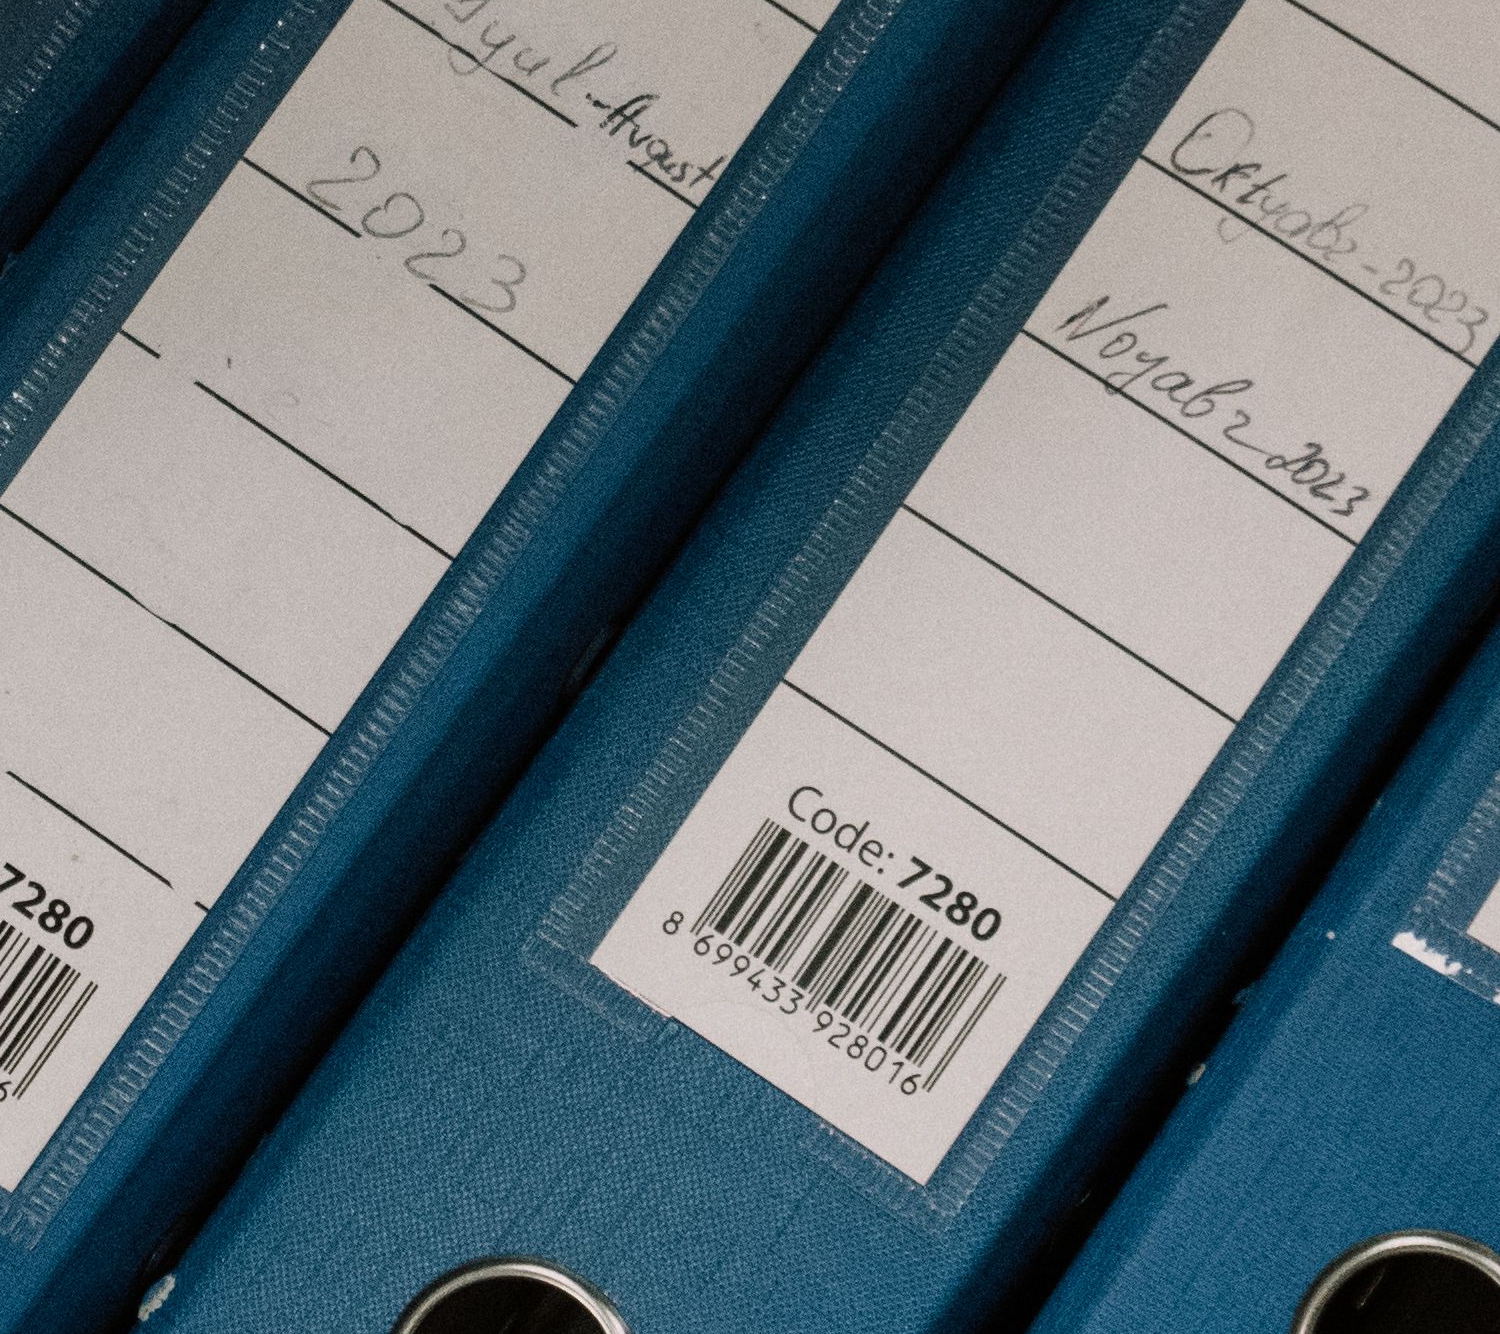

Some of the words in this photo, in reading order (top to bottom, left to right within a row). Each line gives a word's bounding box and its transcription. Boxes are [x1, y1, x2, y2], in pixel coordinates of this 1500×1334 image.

[306, 146, 526, 313] 2023
[788, 786, 895, 874] Code:
[896, 857, 1001, 942] 7280
[663, 911, 684, 935] 8
[693, 933, 804, 1017] 699433
[813, 1012, 922, 1097] 928016
